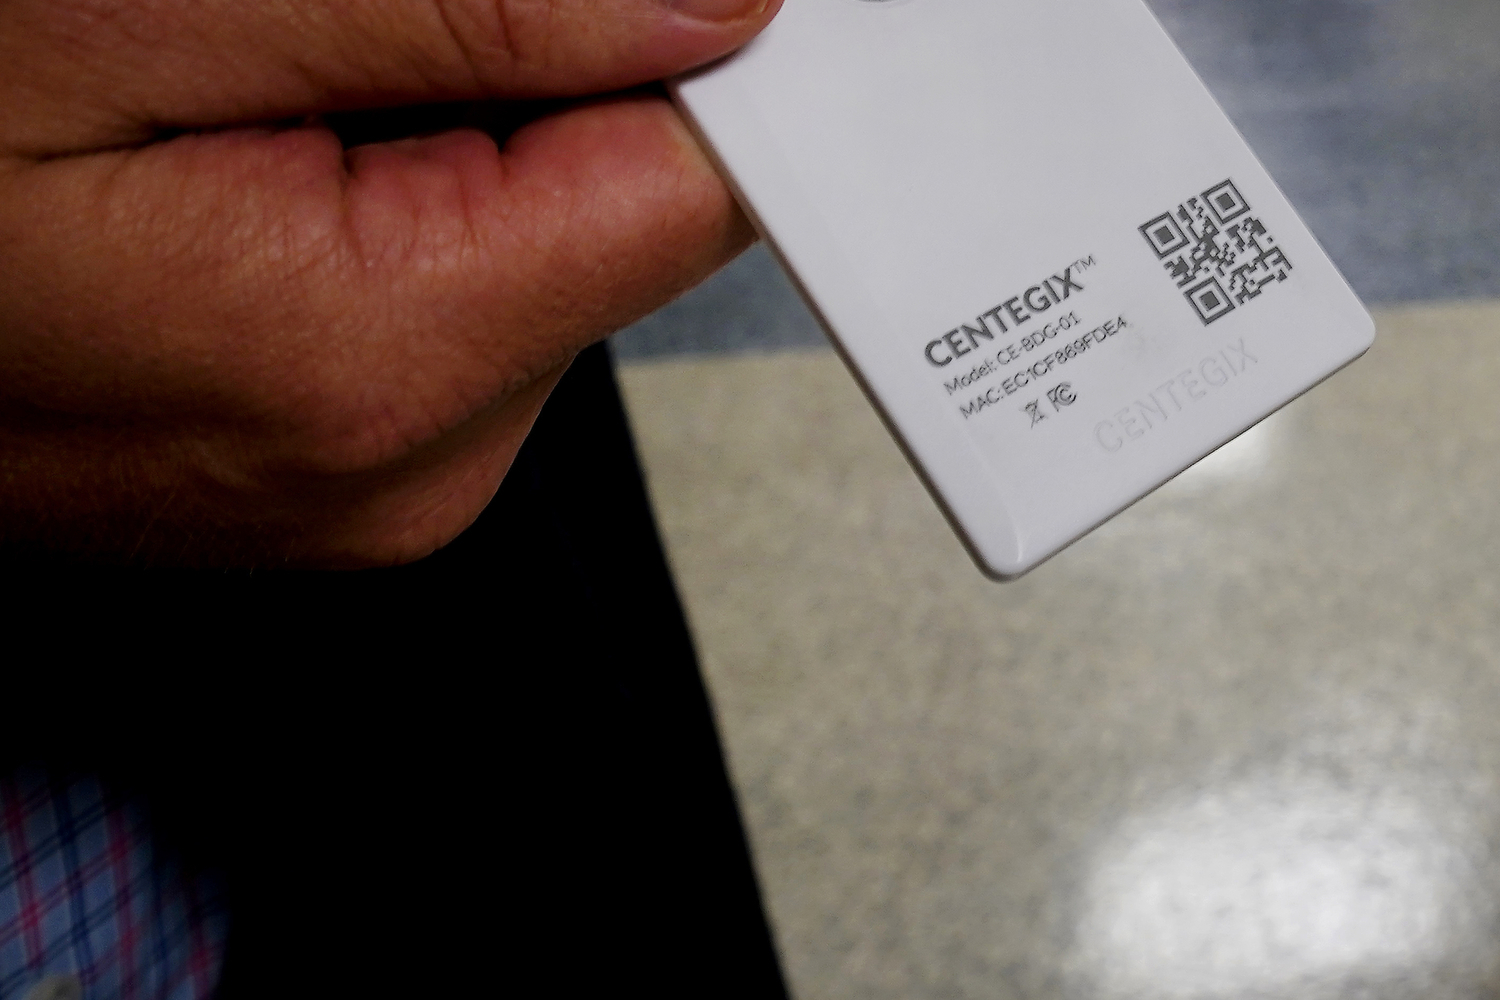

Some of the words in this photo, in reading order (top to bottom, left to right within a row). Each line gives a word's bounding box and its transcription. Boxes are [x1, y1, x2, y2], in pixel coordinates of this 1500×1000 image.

[944, 358, 997, 396] Model:
[997, 311, 1082, 365] CE-BDG-01
[1093, 337, 1258, 452] CENTEGIX
